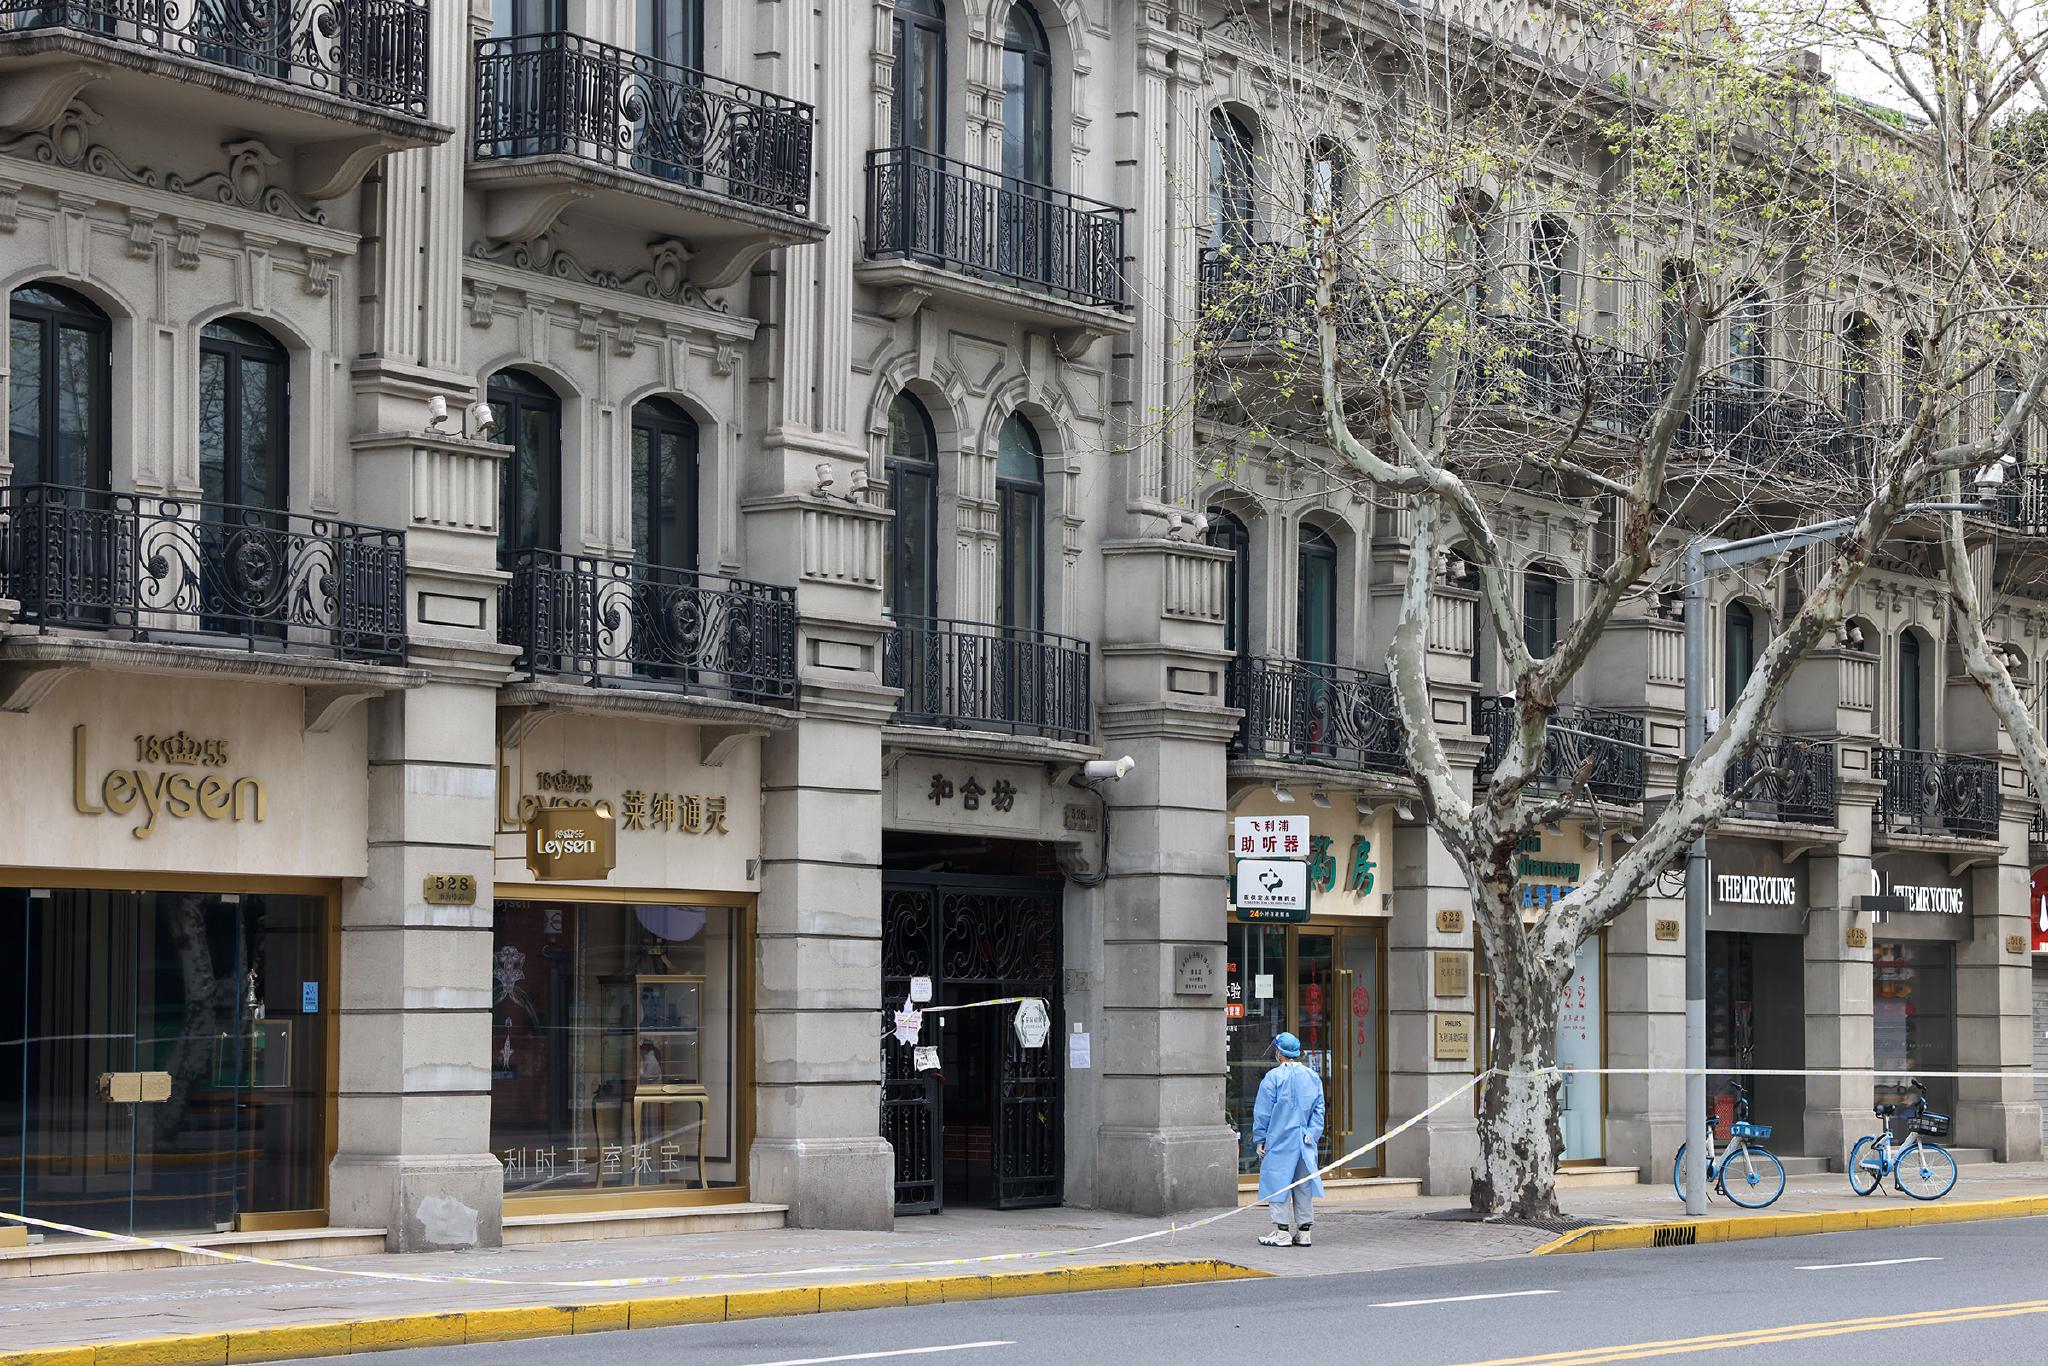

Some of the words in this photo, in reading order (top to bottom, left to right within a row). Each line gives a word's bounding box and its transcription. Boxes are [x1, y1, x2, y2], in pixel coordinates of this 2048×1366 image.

[73, 724, 266, 839] Leysen
[927, 773, 1018, 813] 和合坊
[621, 789, 729, 836] 莱绅通灵
[1250, 820, 1289, 832] 飞利浦
[537, 829, 598, 859] Leysen
[1241, 835, 1299, 853] 助听器
[1518, 857, 1580, 883] pharmacy
[435, 876, 469, 891] 528
[1521, 884, 1575, 908] 点零售
[1442, 911, 1461, 922] 522
[1660, 921, 1676, 931] 520
[504, 1142, 683, 1180] 利时王室珠宝
